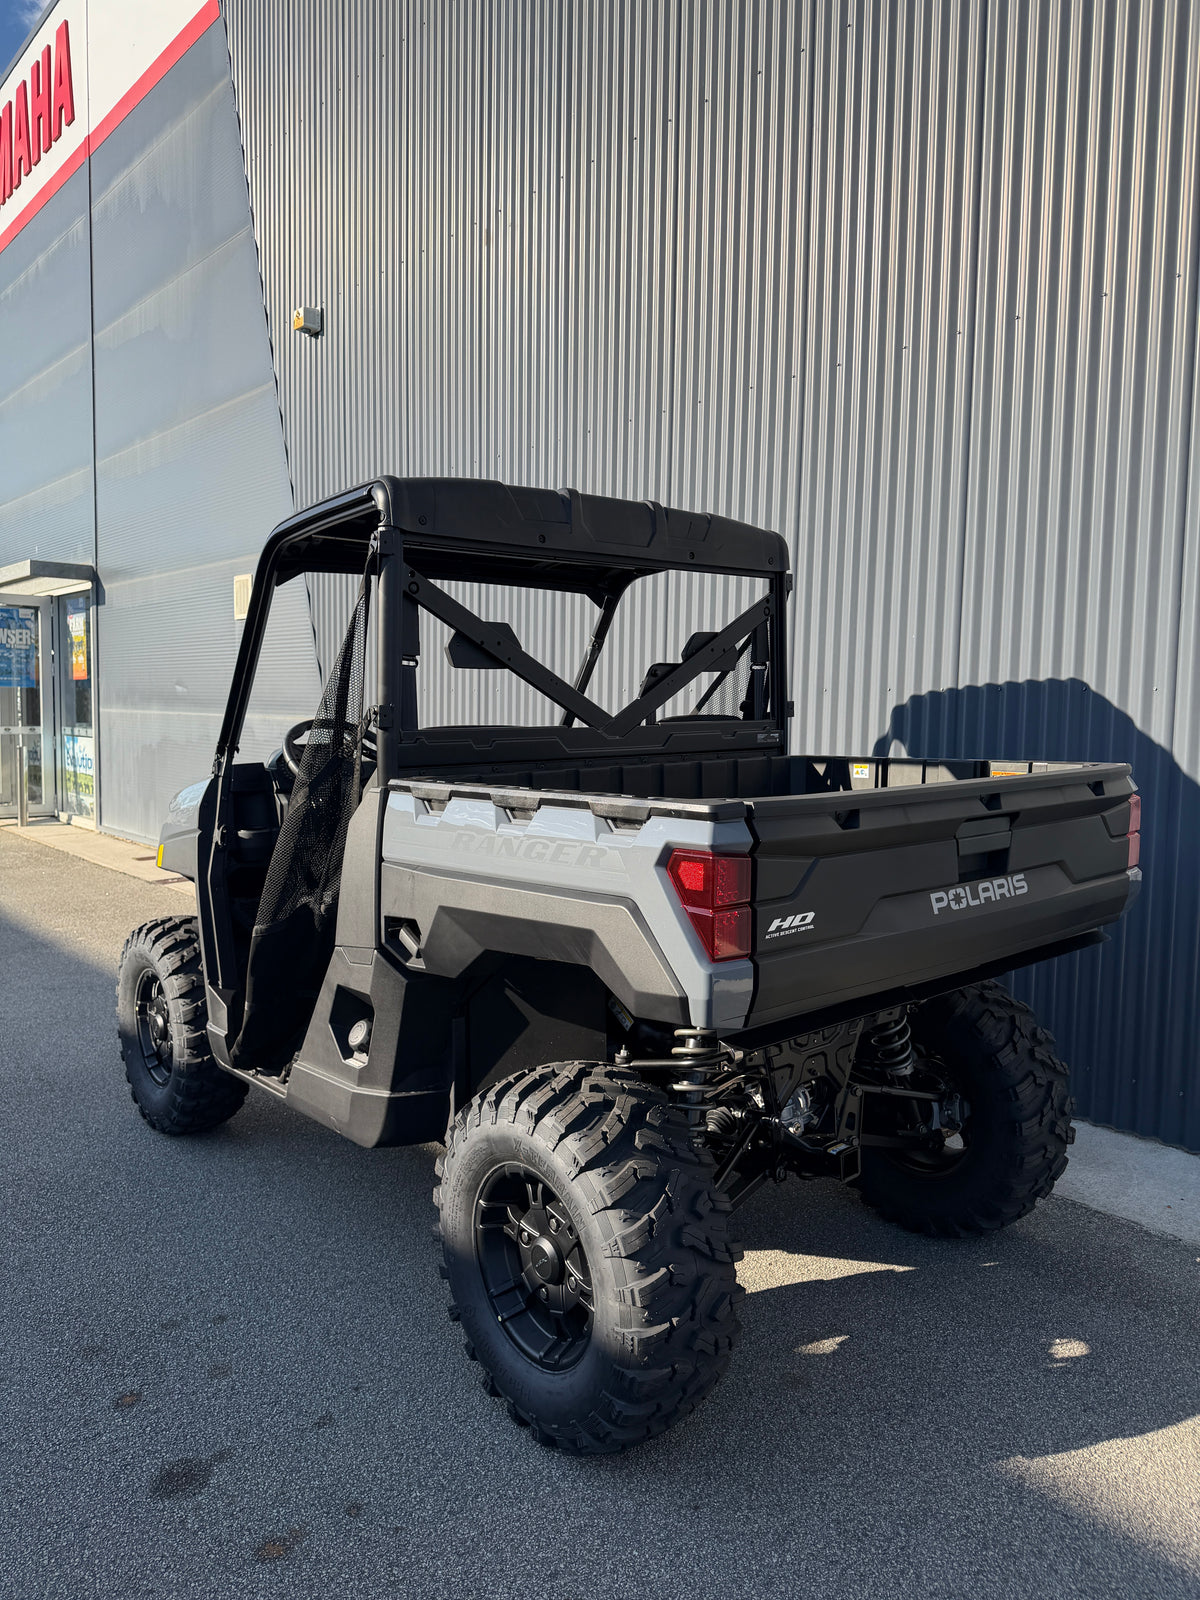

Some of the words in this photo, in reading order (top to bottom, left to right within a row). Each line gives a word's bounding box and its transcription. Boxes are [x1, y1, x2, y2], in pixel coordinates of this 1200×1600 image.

[450, 830, 610, 867] RANGER
[929, 873, 1028, 914] POLARIS
[767, 911, 816, 932] HD
[780, 928, 797, 936] DESCENT
[797, 924, 815, 932] CONTROL
